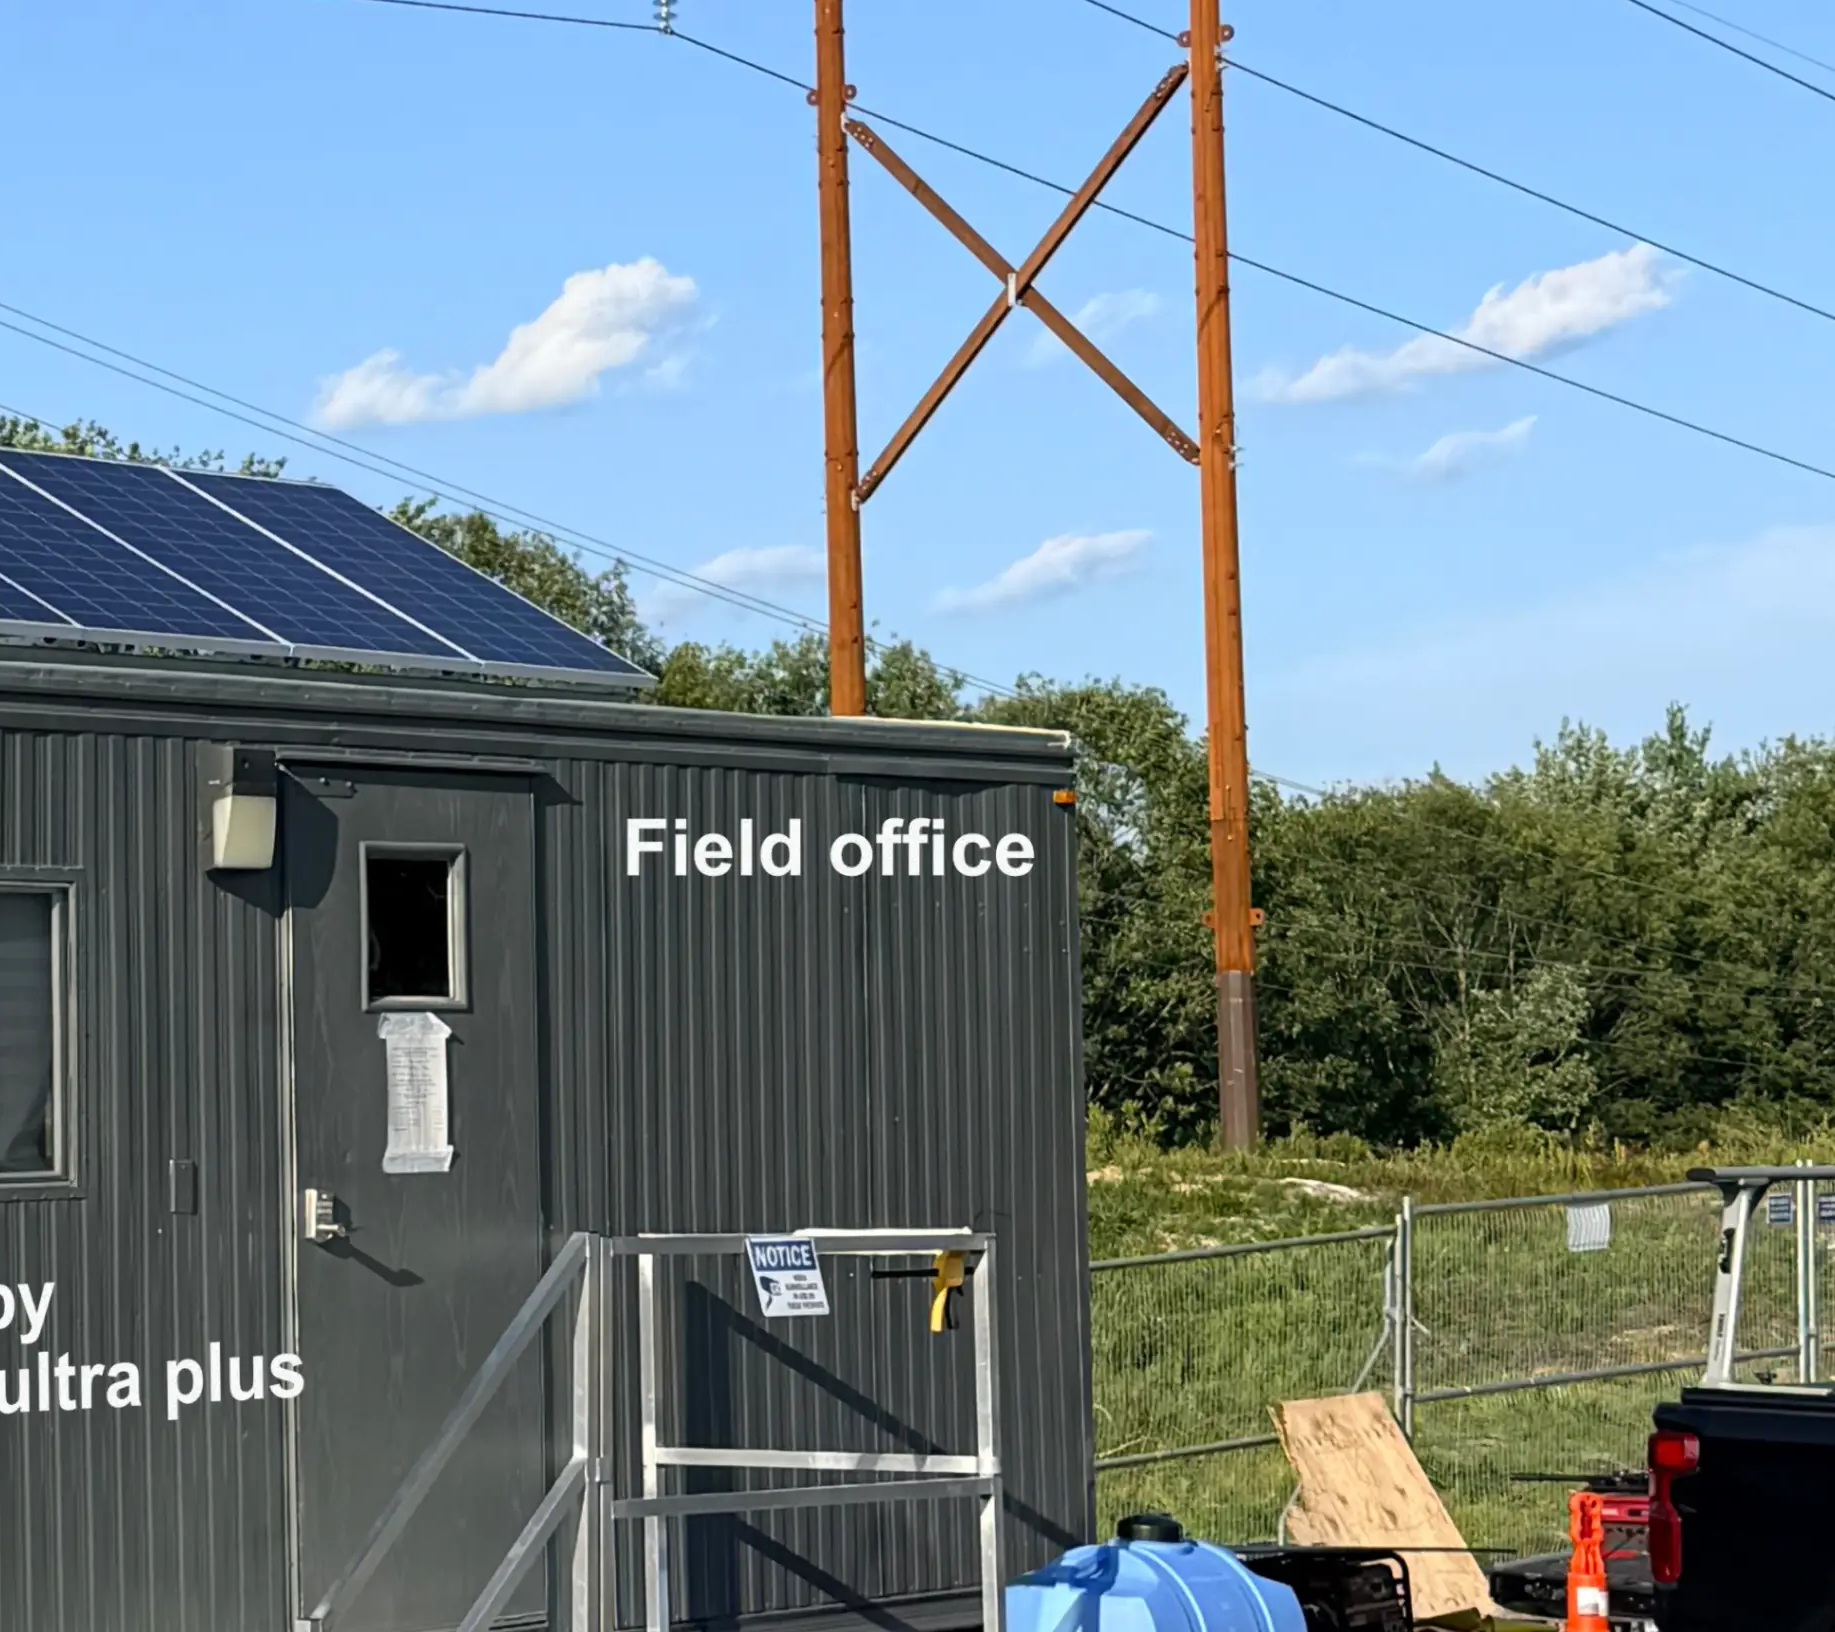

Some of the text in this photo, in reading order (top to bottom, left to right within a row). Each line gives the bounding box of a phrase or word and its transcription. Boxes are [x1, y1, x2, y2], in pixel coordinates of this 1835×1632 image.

[627, 817, 1035, 877] Field office
[754, 1244, 812, 1267] NOTICE
[167, 1341, 304, 1421] plus
